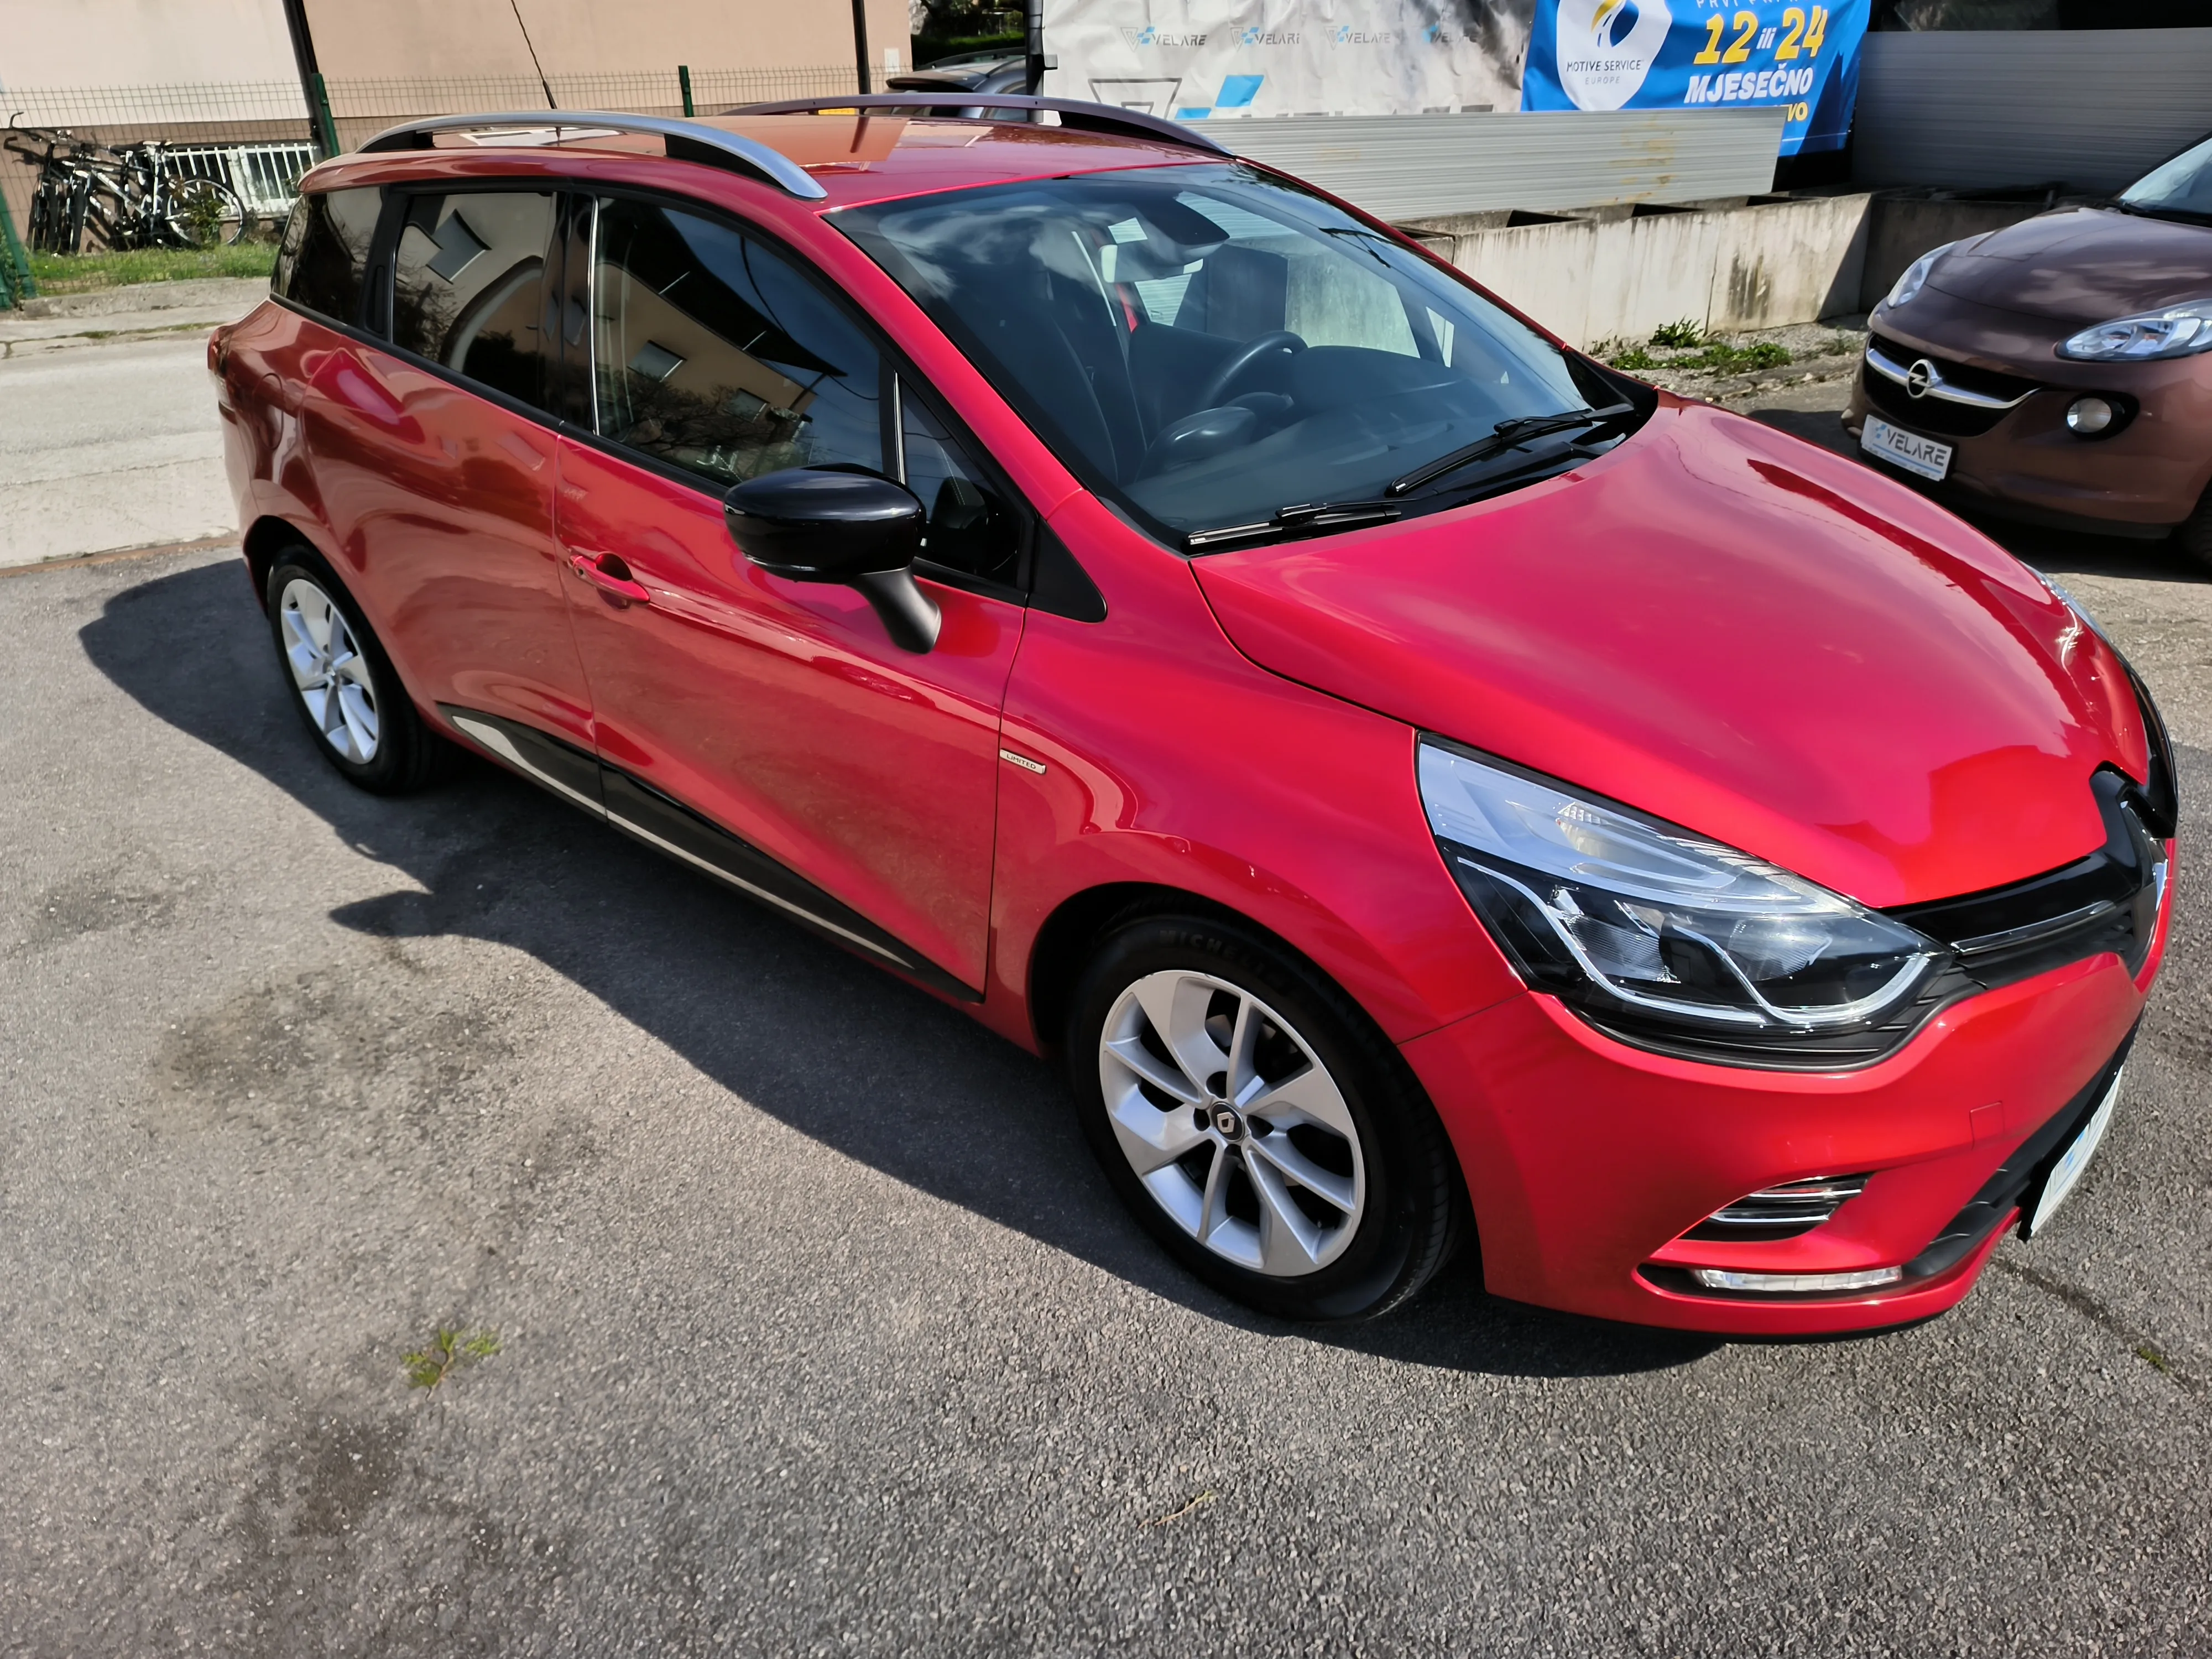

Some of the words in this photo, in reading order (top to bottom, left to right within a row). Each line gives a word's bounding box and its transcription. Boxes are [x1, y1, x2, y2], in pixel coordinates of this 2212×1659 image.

[1151, 33, 1207, 46] VELARE
[1693, 11, 1759, 64] 12
[1756, 28, 1777, 49] ili
[1774, 6, 1828, 60] 24
[1567, 61, 1602, 72] MOTIVE
[1603, 60, 1641, 71] SERVICE
[1585, 76, 1620, 85] EUROPE
[1683, 63, 1813, 104] MJESEČNO
[1887, 429, 1947, 467] VELARE
[1006, 753, 1036, 769] LIMITED
